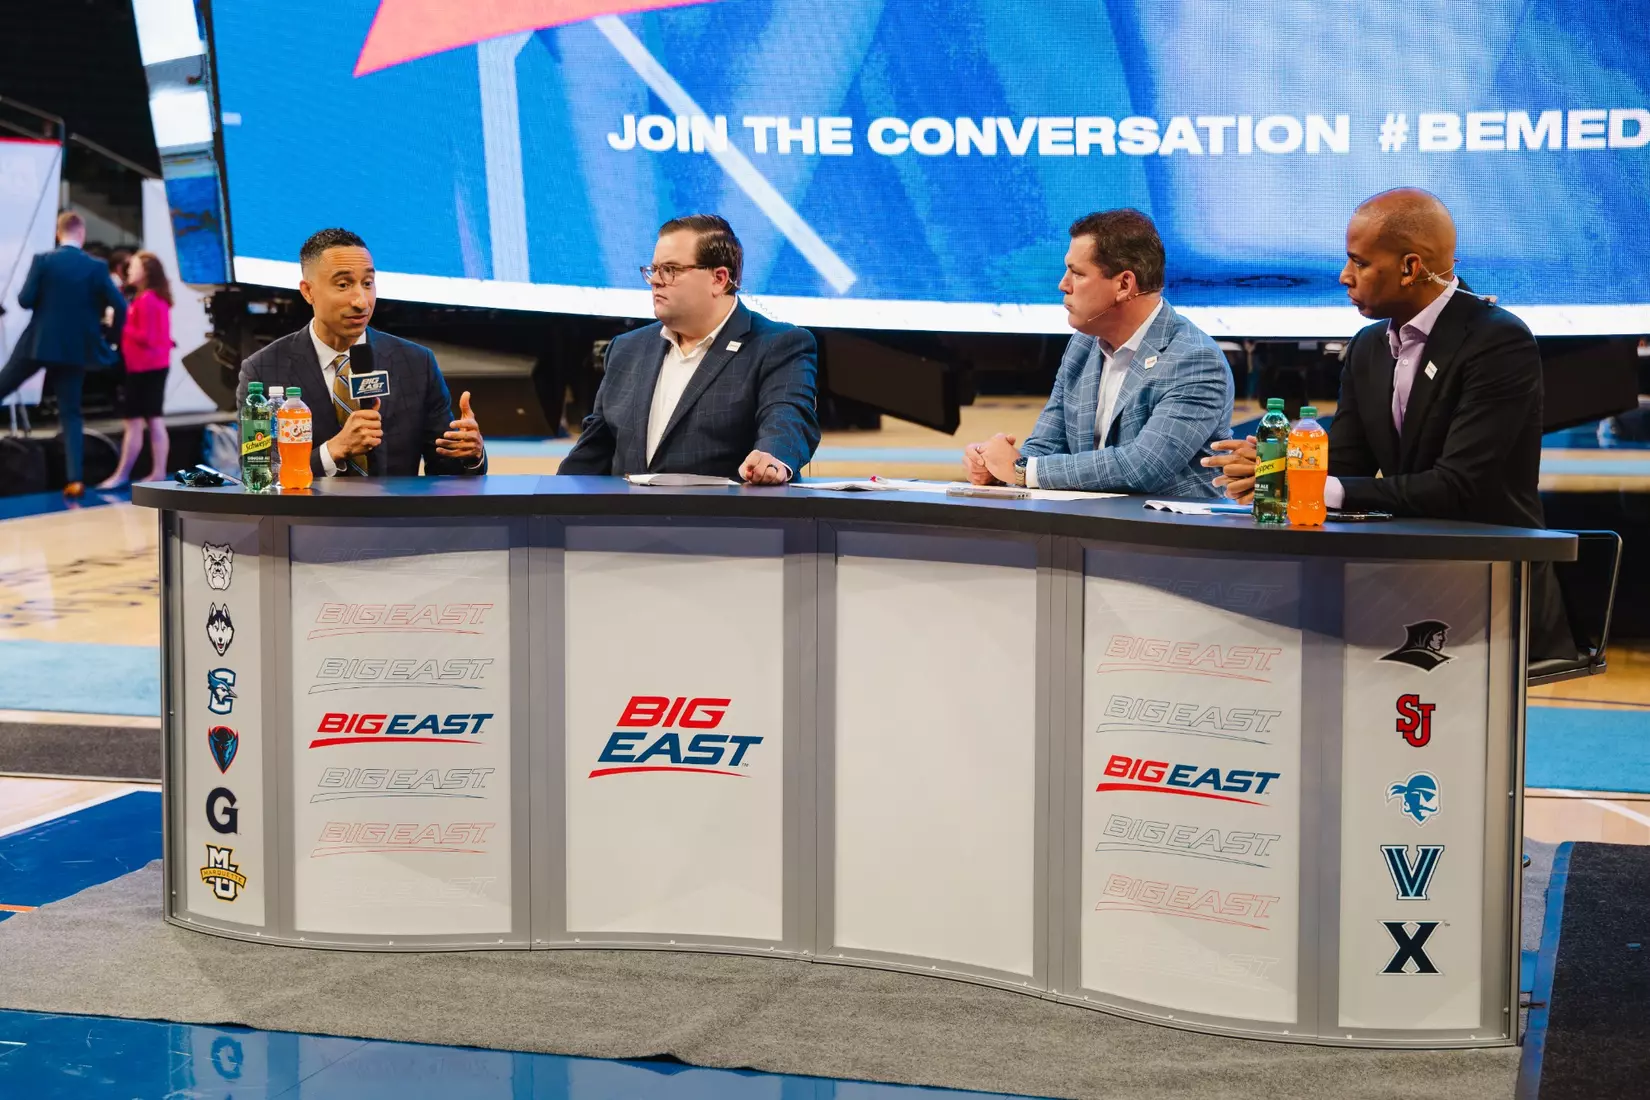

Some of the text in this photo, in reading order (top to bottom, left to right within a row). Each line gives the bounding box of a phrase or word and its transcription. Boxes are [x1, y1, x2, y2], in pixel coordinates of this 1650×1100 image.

[607, 114, 728, 153] JOIN
[743, 116, 854, 156] THE
[867, 114, 1350, 157] CONVERSATION
[358, 382, 384, 391] EAST
[362, 376, 380, 385] BIG
[316, 712, 495, 735] BIG EAST
[616, 695, 732, 729] BIG
[597, 731, 764, 767] EAST
[1103, 754, 1281, 795] BIG EAST
[206, 787, 239, 834] G
[203, 869, 244, 885] MARQUETTE
[1380, 845, 1445, 900] V
[1376, 920, 1445, 975] X
